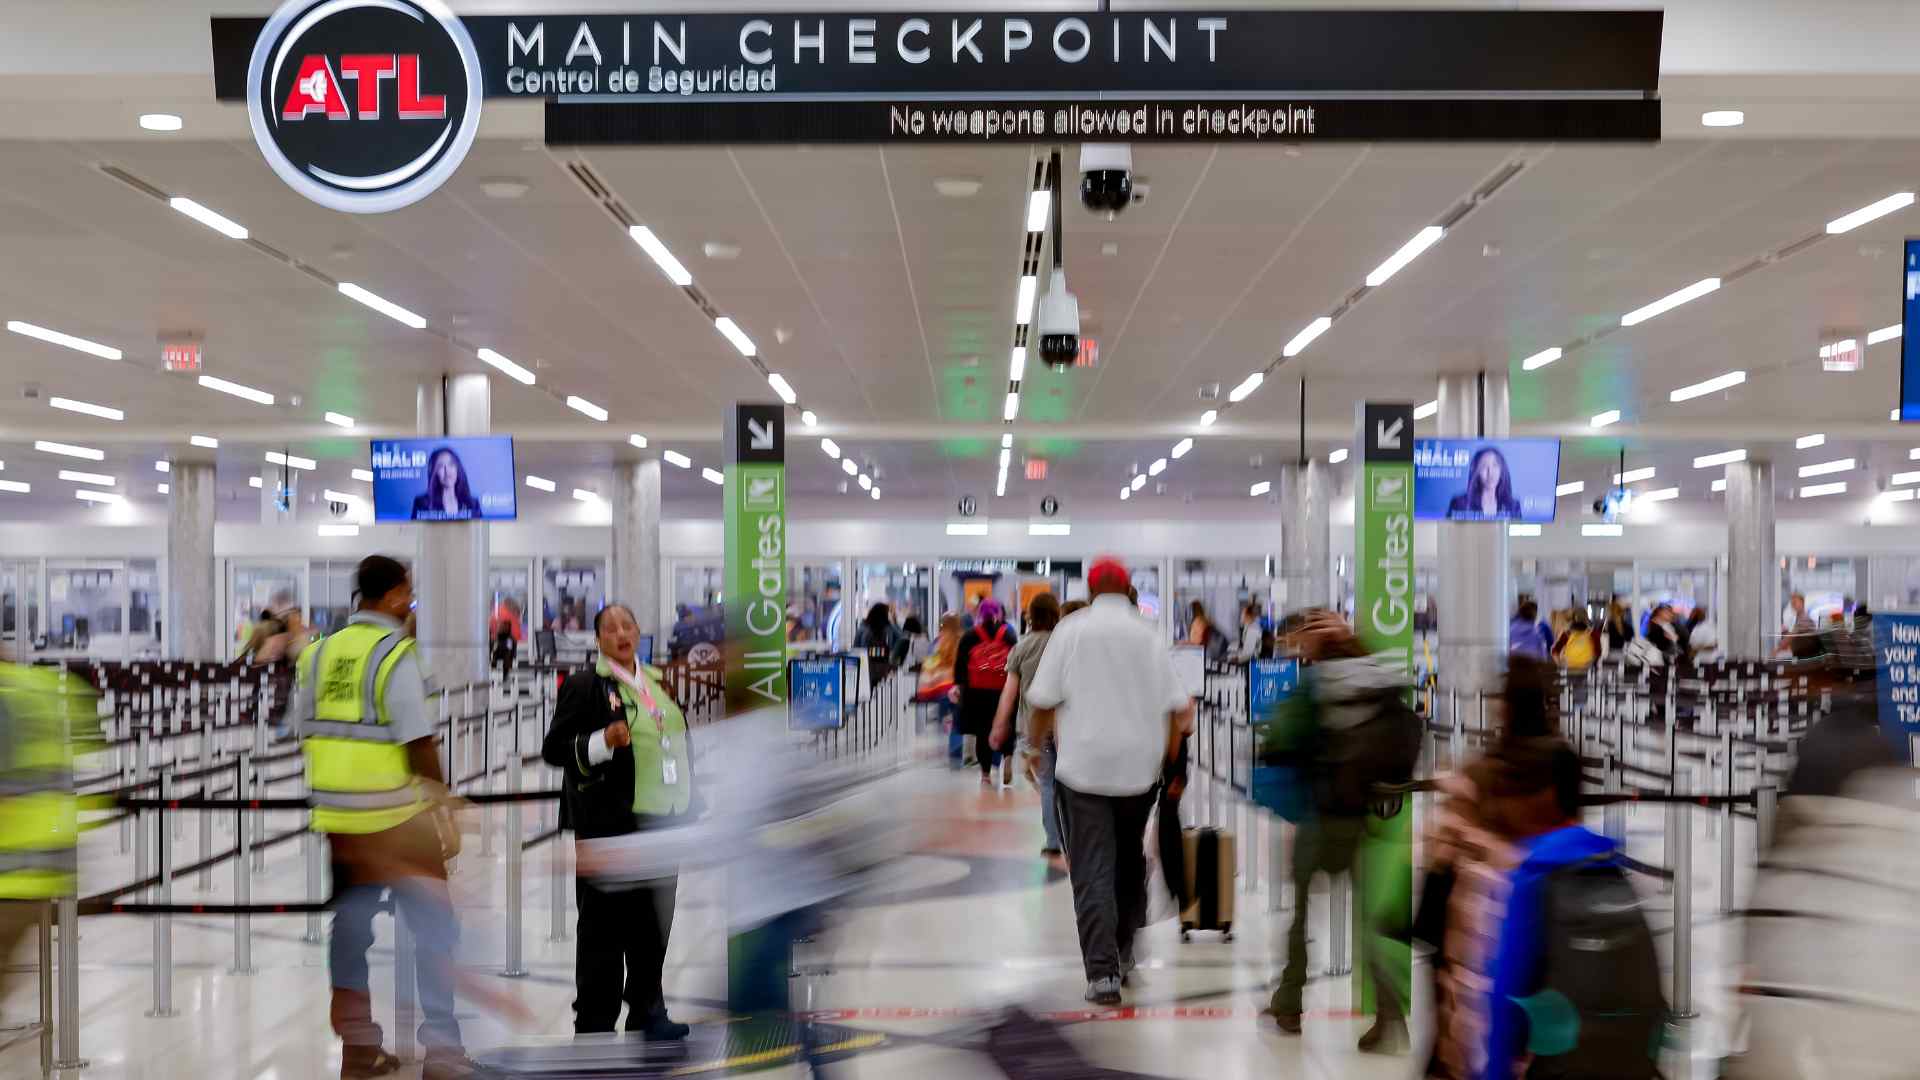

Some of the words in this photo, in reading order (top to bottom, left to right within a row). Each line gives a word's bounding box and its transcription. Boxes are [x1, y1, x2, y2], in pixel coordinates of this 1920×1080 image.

[507, 20, 686, 66] MAIN
[739, 17, 1228, 65] CHECKPOINT
[282, 54, 447, 120] ATL
[506, 65, 599, 93] Control
[608, 65, 640, 93] de
[648, 64, 777, 96] Seguridad
[891, 104, 925, 135] No
[932, 108, 1046, 140] weapons
[1054, 103, 1147, 135] allowed
[1156, 103, 1175, 135] in
[1182, 103, 1316, 140] checkpoint
[746, 514, 782, 635] Gates
[1372, 513, 1409, 635] Gates
[744, 651, 782, 701] All
[1884, 645, 1917, 665] your
[1890, 665, 1904, 683] to
[1891, 685, 1918, 703] and
